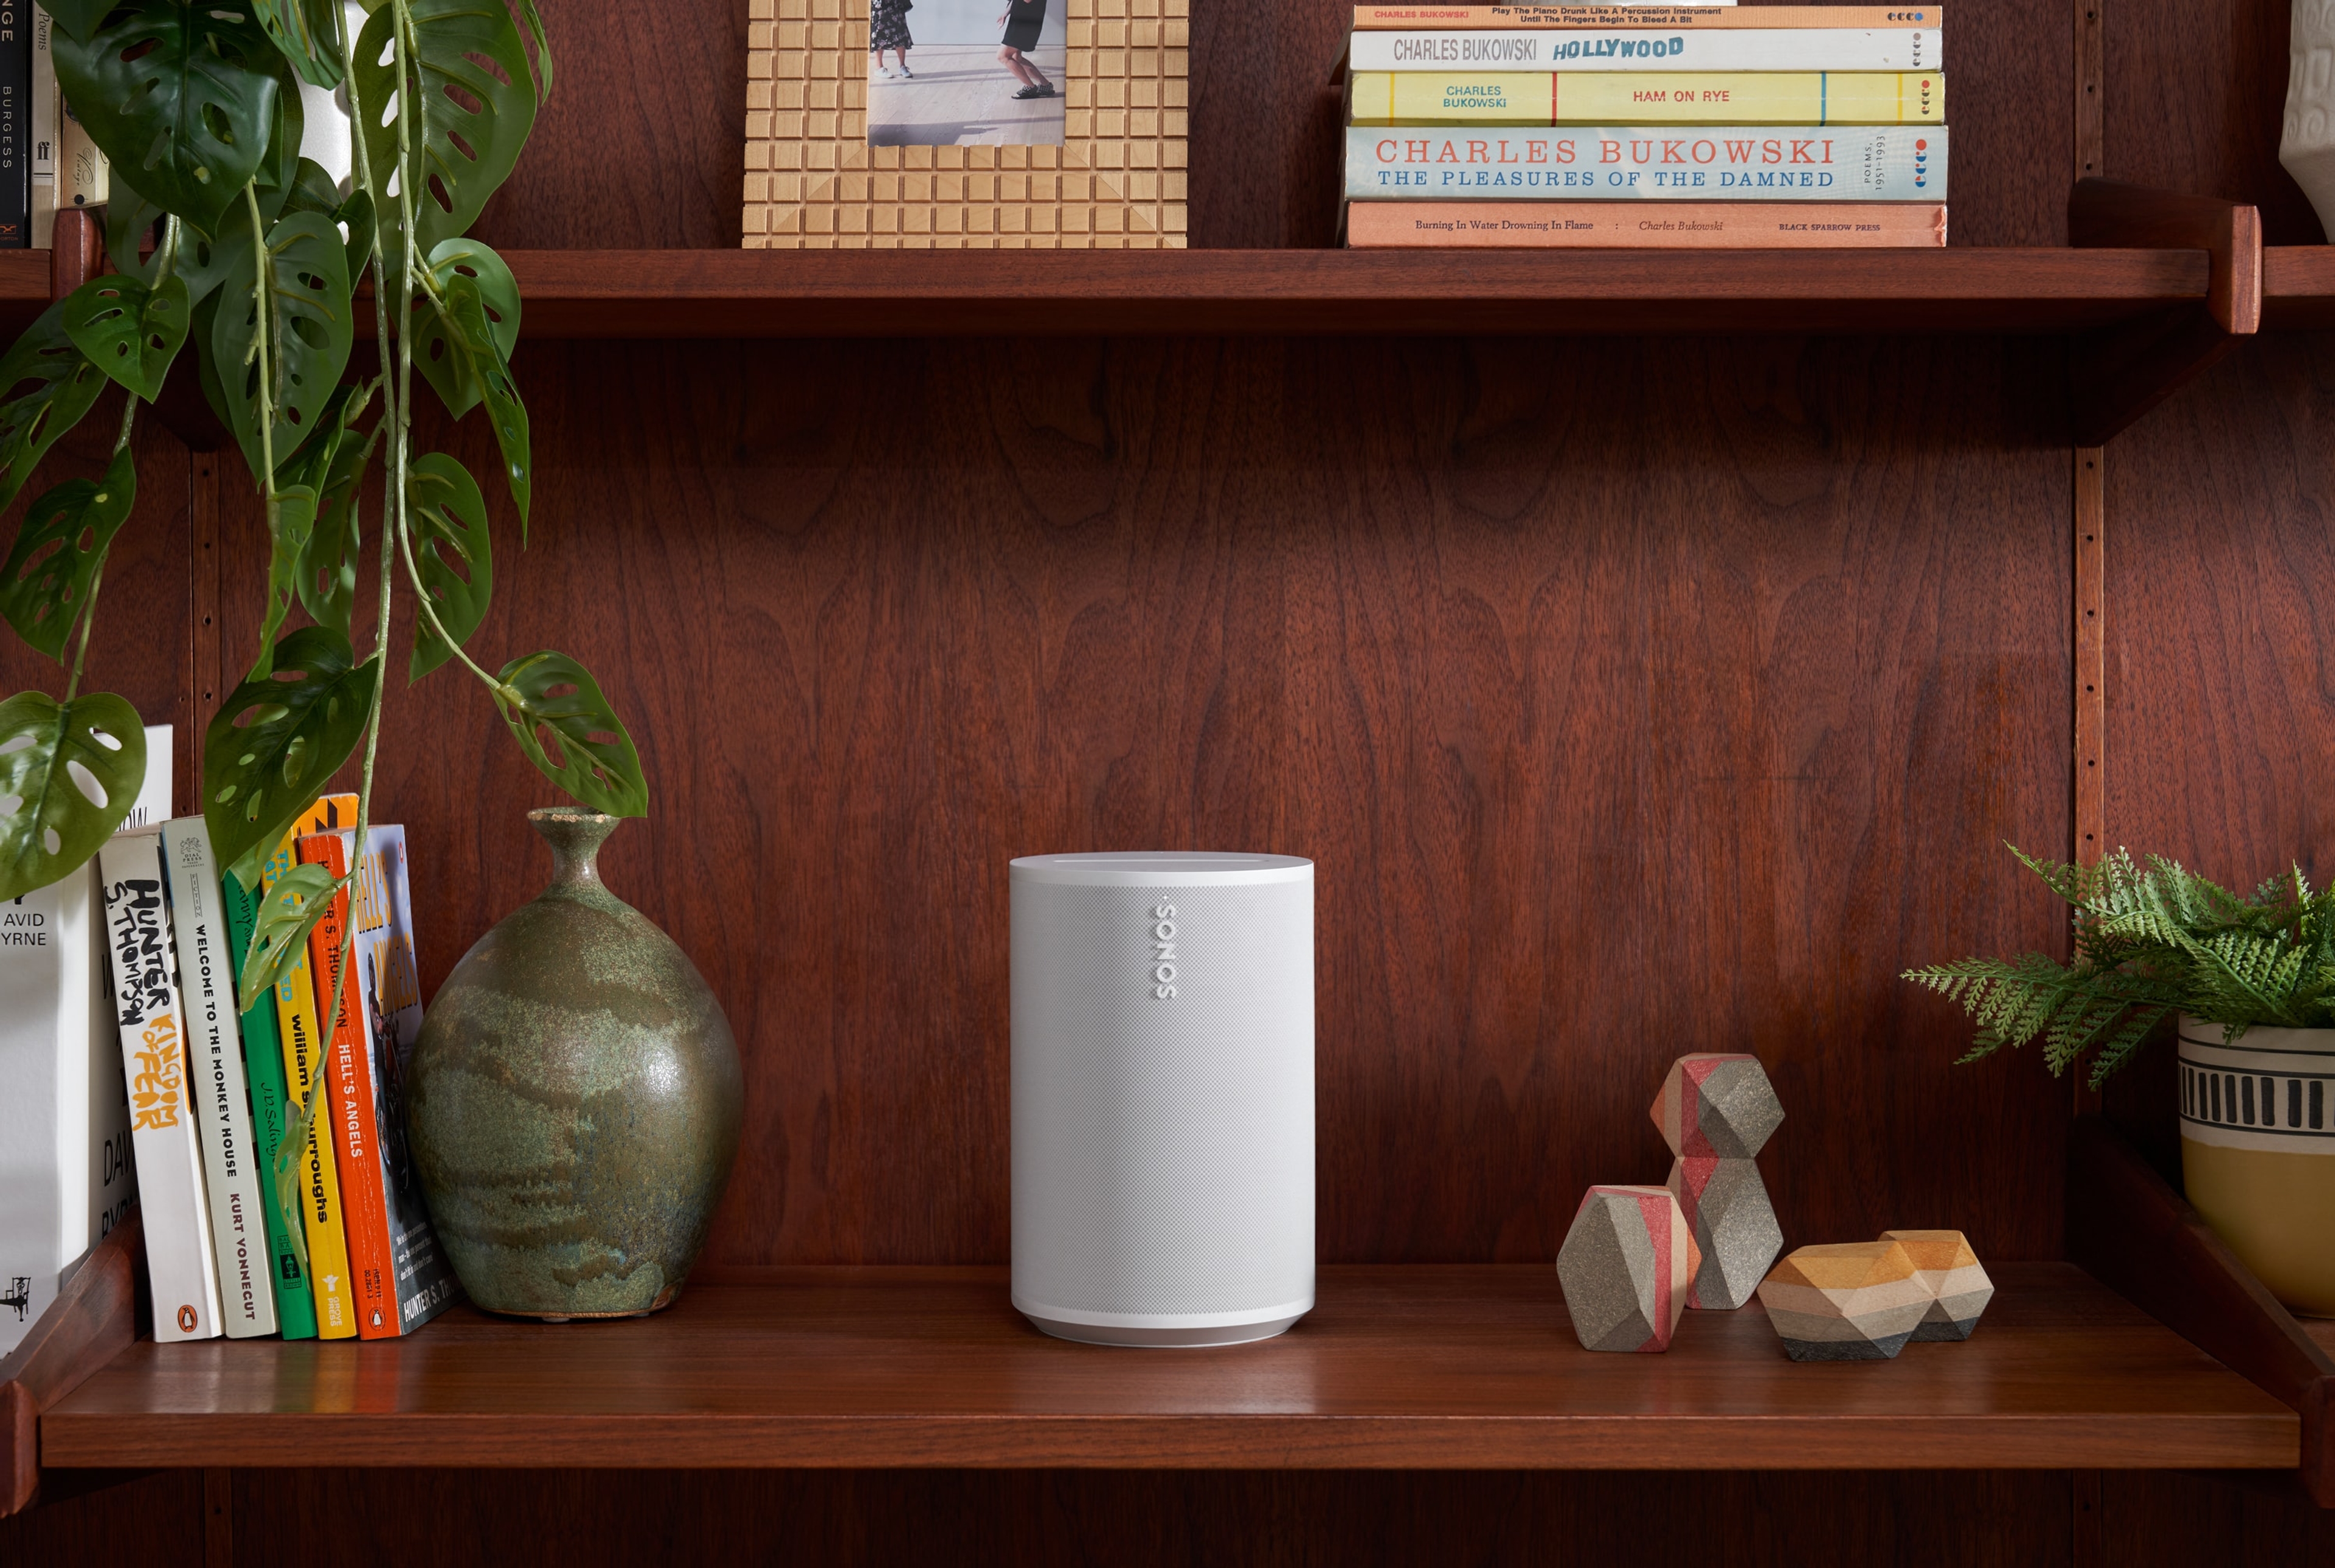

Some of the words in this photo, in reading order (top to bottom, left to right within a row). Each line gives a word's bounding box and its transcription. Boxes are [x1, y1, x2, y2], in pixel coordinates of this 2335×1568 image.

[1492, 7, 1511, 16] Play
[1563, 16, 1596, 24] Fingers
[1600, 16, 1624, 24] Begin
[38, 13, 50, 50] Poems
[1394, 39, 1458, 61] CHARLES
[1463, 39, 1537, 61] BUKOWSKI
[1552, 36, 1684, 61] HOLLYWOOD
[1447, 86, 1501, 95] CHARLES
[1634, 91, 1666, 102] HAM
[1674, 91, 1695, 102] ON
[1703, 91, 1730, 102] RYE
[3, 86, 12, 168] BURGESS
[37, 142, 50, 160] ff
[73, 147, 93, 185] Vintage
[1376, 140, 1576, 164] CHARLES
[1599, 140, 1834, 164] BUKOWSKI
[1864, 142, 1873, 184] POEMS,
[1379, 171, 1427, 185] THE
[1442, 171, 1594, 186] PLEASURES
[1608, 171, 1640, 186] OF
[1655, 171, 1705, 186] THE
[1720, 171, 1833, 186] DAMNED
[1415, 220, 1453, 231] Burning
[1456, 221, 1466, 230] In
[1470, 221, 1498, 230] Water
[1502, 220, 1548, 232] Drowning
[1551, 221, 1562, 230] In
[1565, 220, 1593, 230] Flame
[1639, 221, 1675, 230] Charles
[1678, 221, 1723, 231] Bukowski
[277, 849, 289, 877] TH
[104, 882, 128, 910] S.
[191, 874, 202, 917] FICTION
[236, 883, 254, 928] anny
[4, 913, 44, 926] AVID
[325, 925, 336, 939] S.
[1, 933, 46, 945] YRNE
[125, 879, 170, 1010] HUNTER
[1156, 903, 1177, 999] SONOS
[114, 907, 145, 1026] THOMPSON
[196, 924, 214, 997] WELCOME
[373, 931, 418, 1017] ANGELS
[206, 1002, 216, 1021] TO
[209, 1026, 221, 1054] THE
[149, 1013, 181, 1127] KINGDOM
[338, 1044, 355, 1095] HELL'S
[213, 1059, 230, 1122] MONKEY
[265, 1108, 281, 1164] Saling
[292, 1014, 310, 1086] william
[308, 1113, 327, 1224] urroughs
[345, 1100, 363, 1158] ANGELS
[221, 1128, 237, 1178] HOUSE
[229, 1193, 244, 1233] KURT
[236, 1238, 255, 1321] VONNEGUT
[327, 1297, 337, 1327] PRESS
[333, 1296, 342, 1327] GROVE
[404, 1288, 432, 1322] HUNTER
[431, 1284, 441, 1305] S.
